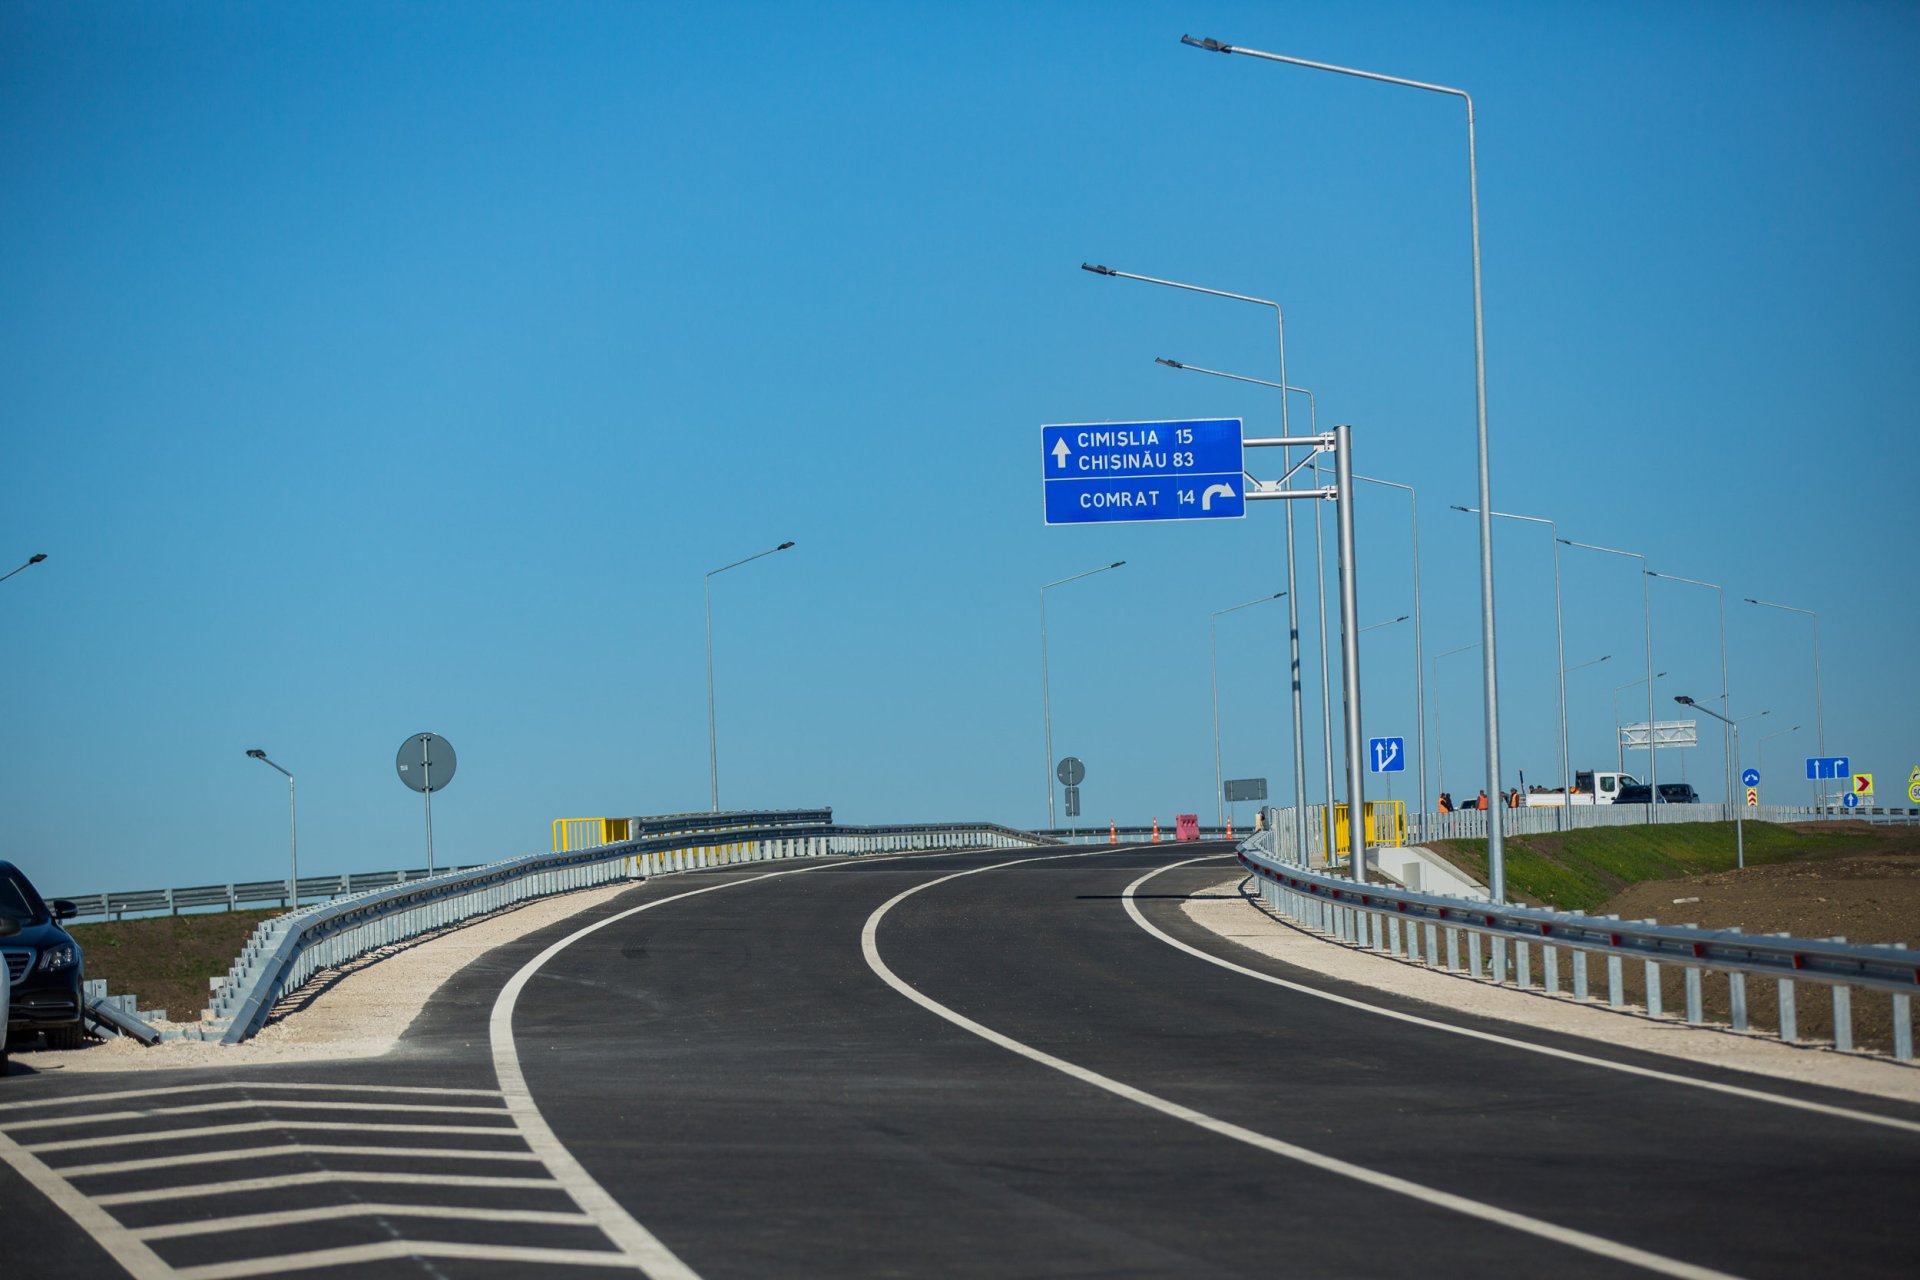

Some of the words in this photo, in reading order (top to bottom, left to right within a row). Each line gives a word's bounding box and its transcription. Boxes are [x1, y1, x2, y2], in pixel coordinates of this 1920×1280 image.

[1077, 430, 1159, 448] CIMIȘLIA
[1175, 429, 1193, 444] 15
[1078, 451, 1167, 470] CHIȘINĂU
[1172, 452, 1194, 467] 83
[1080, 491, 1159, 508] COMRAT
[1176, 490, 1195, 505] 14
